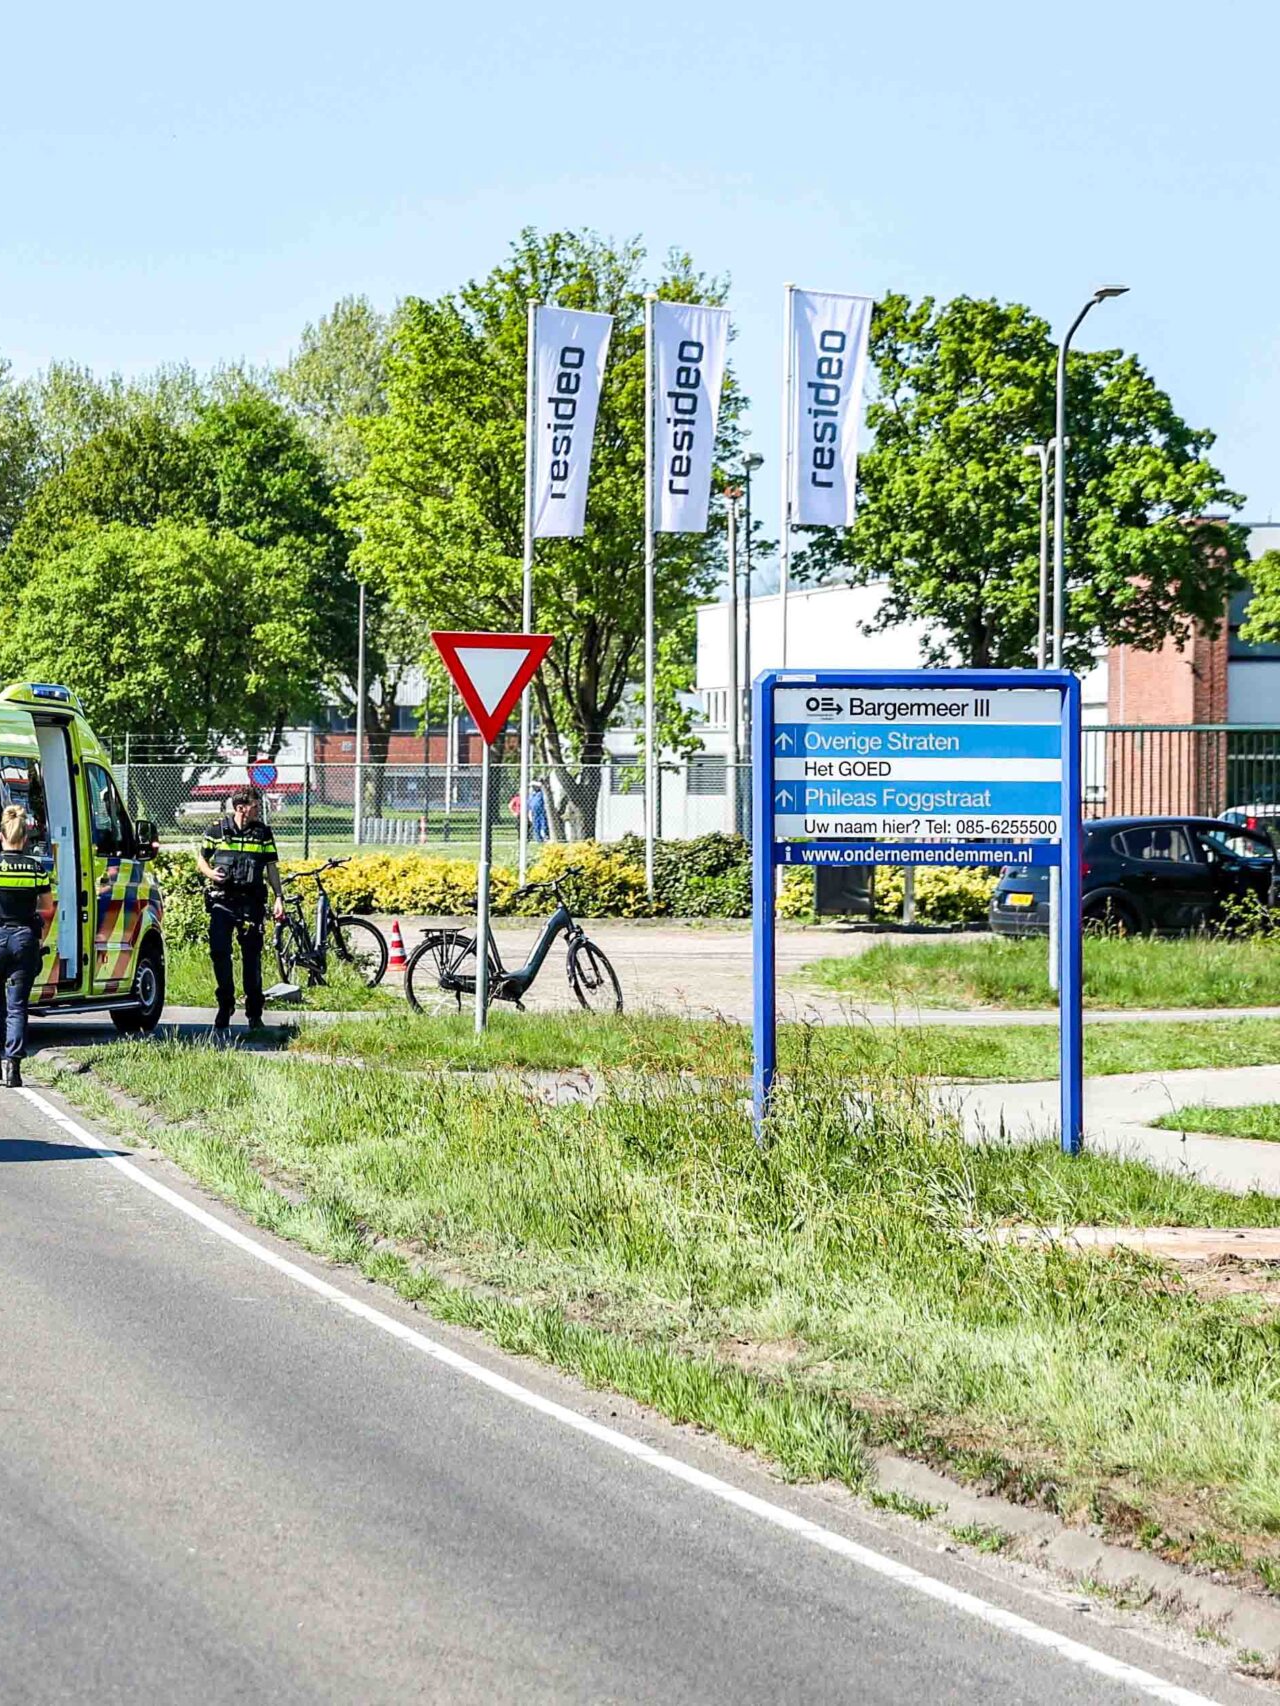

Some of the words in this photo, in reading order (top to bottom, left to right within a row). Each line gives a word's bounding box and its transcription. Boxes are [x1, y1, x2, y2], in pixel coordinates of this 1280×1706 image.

[667, 340, 704, 495] resideo
[807, 329, 847, 488] resideo
[547, 346, 585, 499] resideo
[849, 698, 969, 720] Bargermeer
[804, 732, 882, 754] Overige
[888, 732, 960, 750] Straten
[804, 762, 834, 776] Het
[838, 762, 891, 776] GOED
[805, 789, 877, 806] Phileas
[883, 789, 991, 811] Foggstraat
[804, 820, 830, 834] Uw
[834, 822, 878, 834] naam
[882, 819, 920, 834] hier?
[925, 820, 951, 834] Tel:
[956, 820, 1057, 834] 085-6255500
[802, 847, 1033, 863] www.ondernemendemmen.nl
